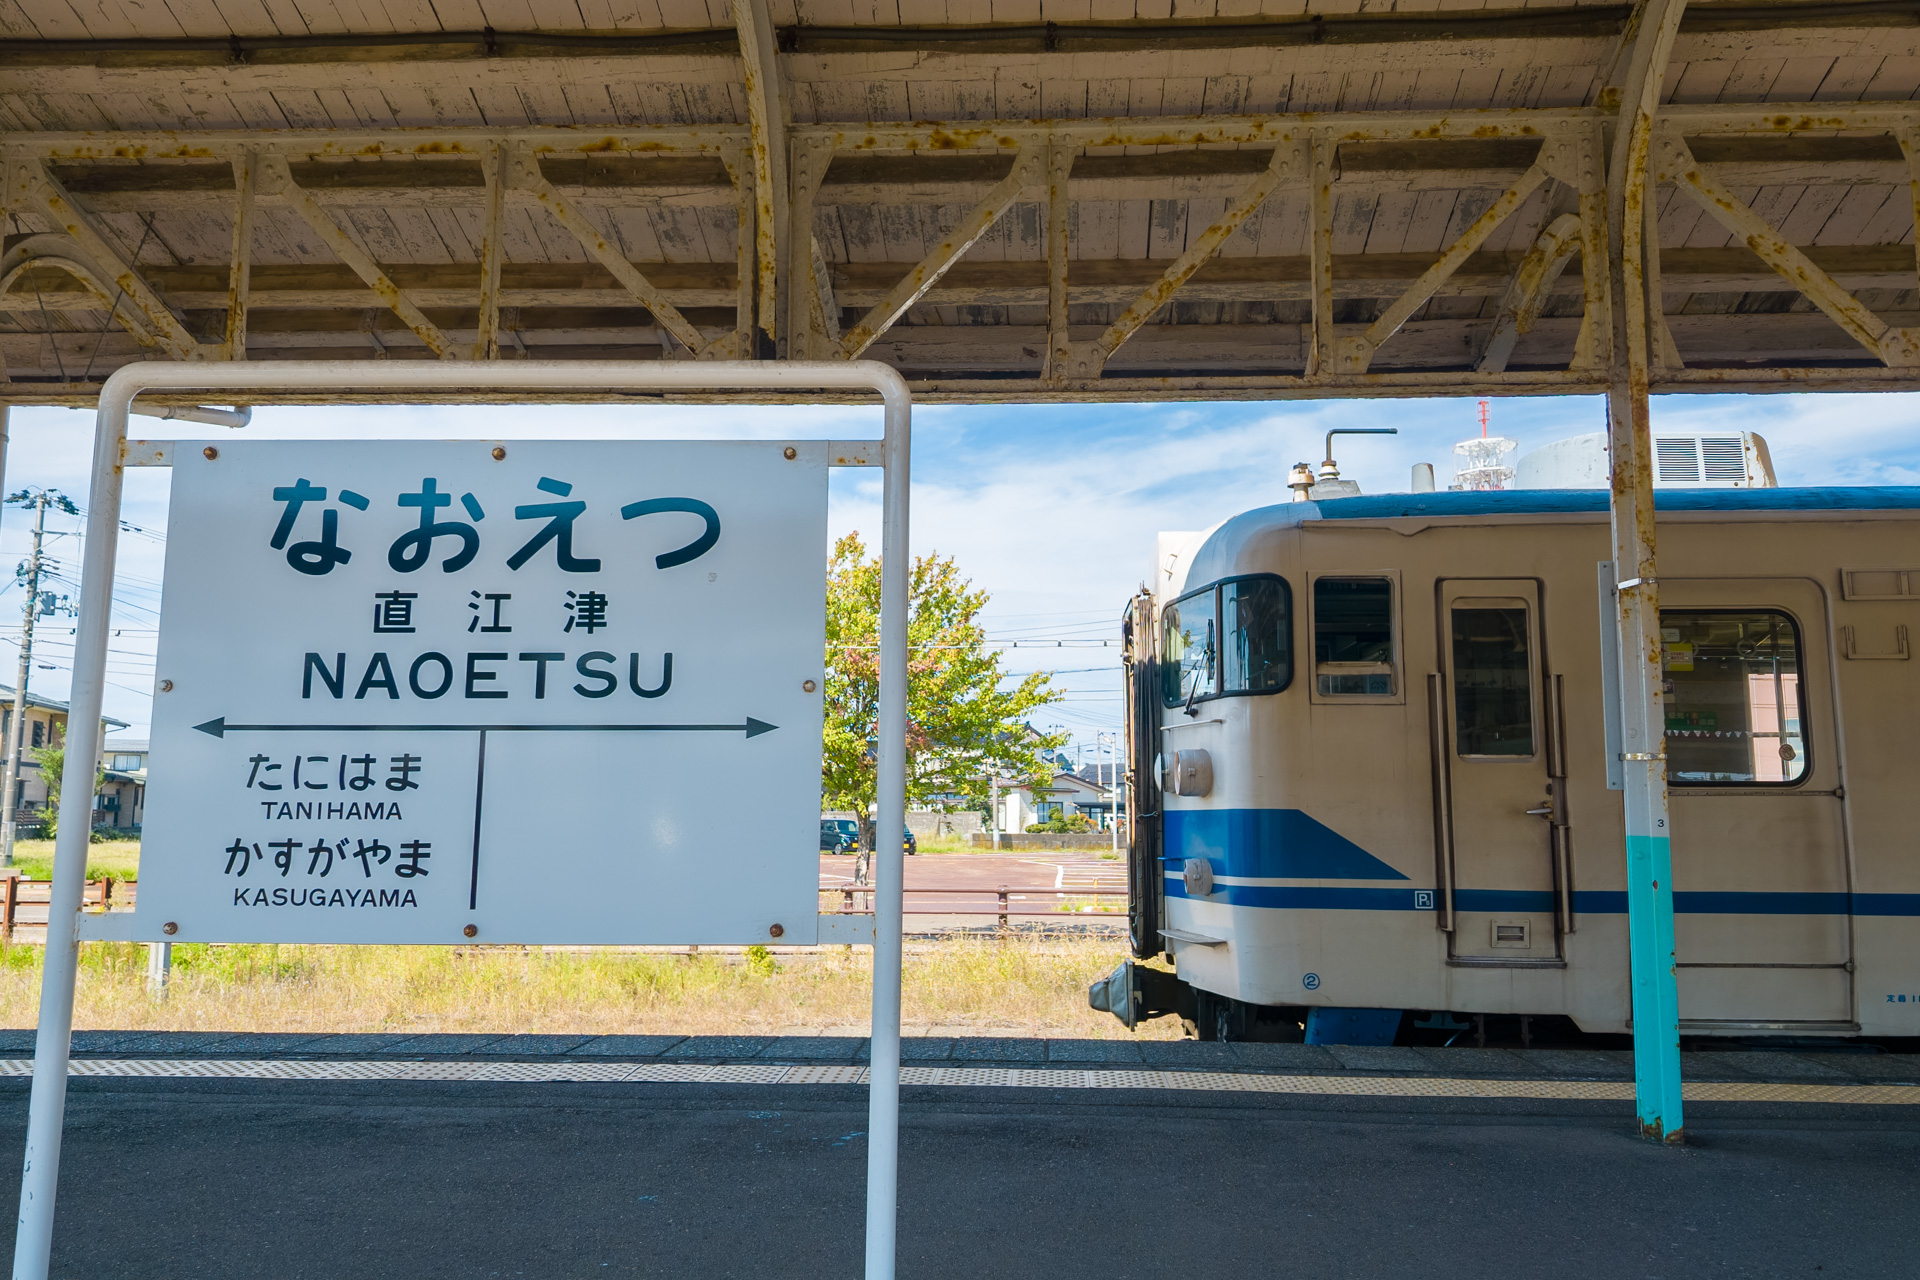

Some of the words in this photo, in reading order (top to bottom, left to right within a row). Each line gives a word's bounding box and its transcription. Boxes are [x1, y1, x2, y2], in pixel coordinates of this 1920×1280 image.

[271, 477, 721, 576] なおえつ
[373, 590, 608, 635] 直江津
[302, 651, 673, 700] NAOETSU
[246, 753, 422, 792] たにはま
[261, 801, 403, 821] TANIHAMA
[1657, 818, 1665, 828] 3
[224, 837, 433, 879] かすがやま
[233, 887, 418, 908] KASUGAYAMA
